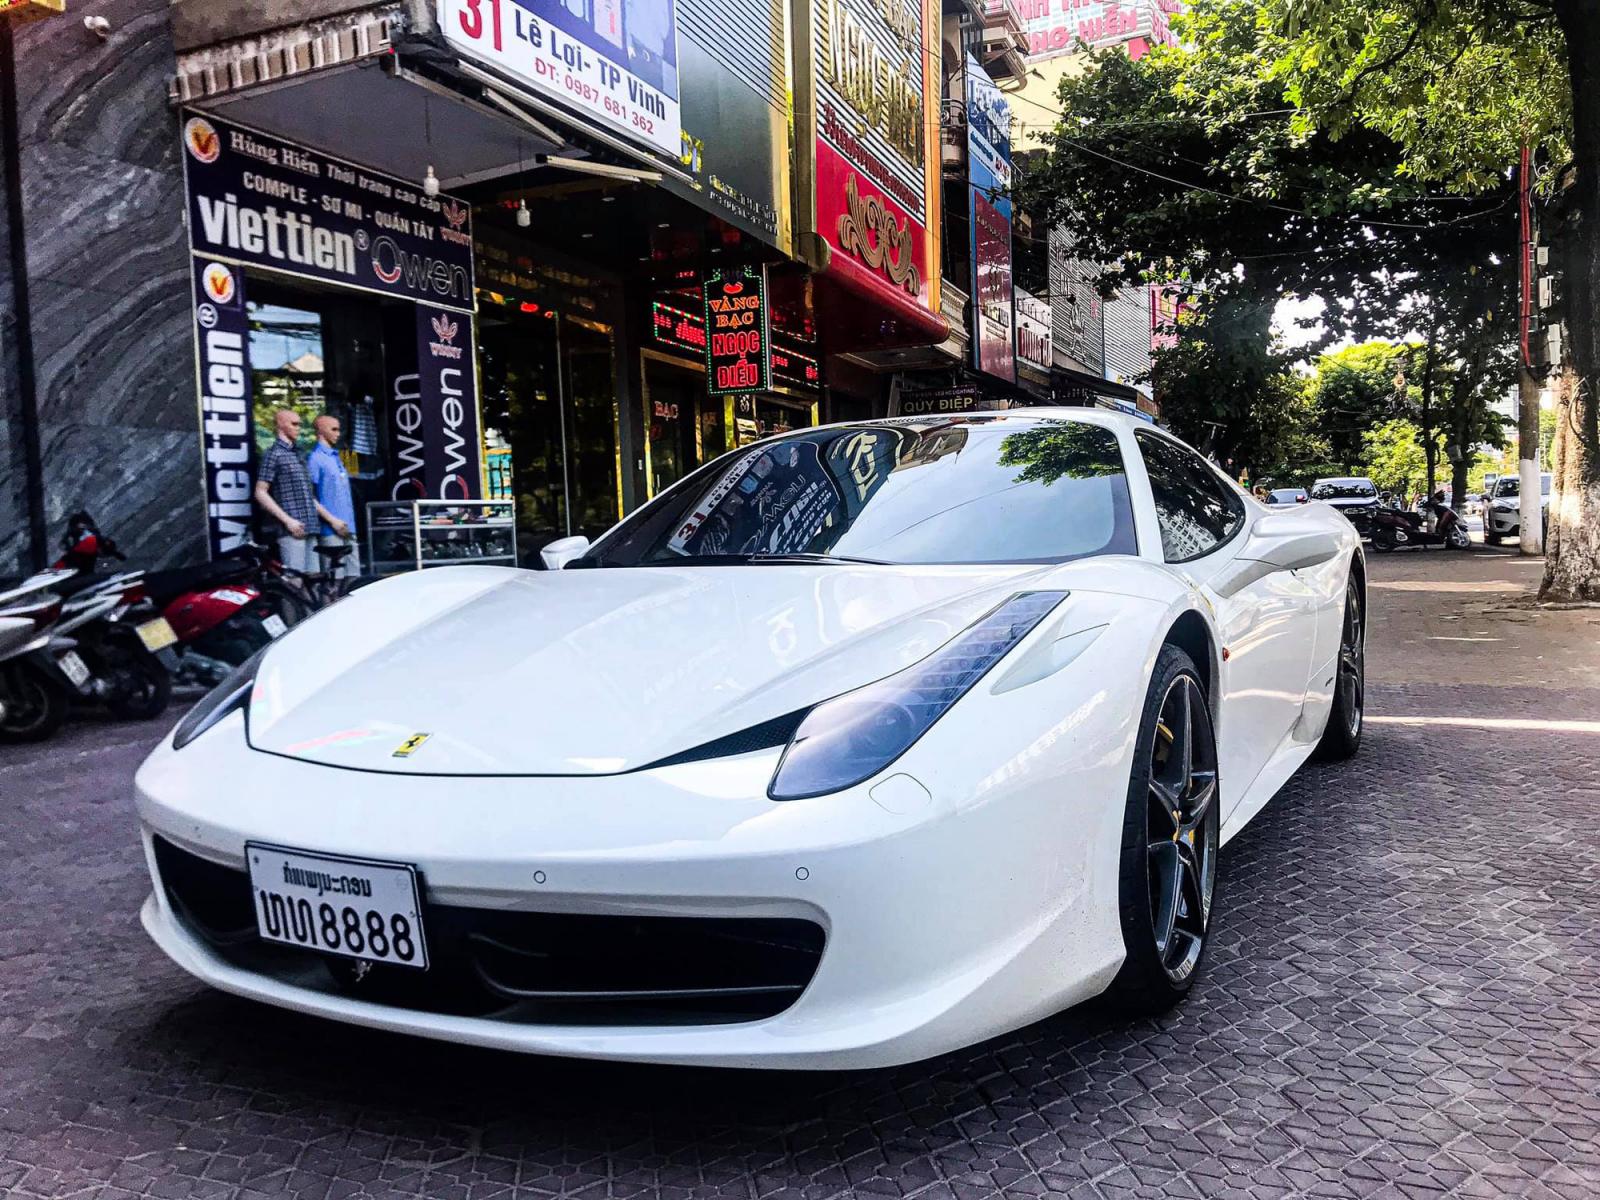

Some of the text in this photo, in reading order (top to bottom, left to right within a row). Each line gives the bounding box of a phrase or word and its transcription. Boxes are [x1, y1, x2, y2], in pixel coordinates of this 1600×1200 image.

[514, 8, 542, 48] Lê
[597, 56, 621, 91] TP
[627, 76, 666, 121] Vinh
[565, 74, 600, 105] 0987
[604, 96, 627, 120] 681
[632, 111, 655, 135] 362
[712, 330, 760, 358] NGỌC
